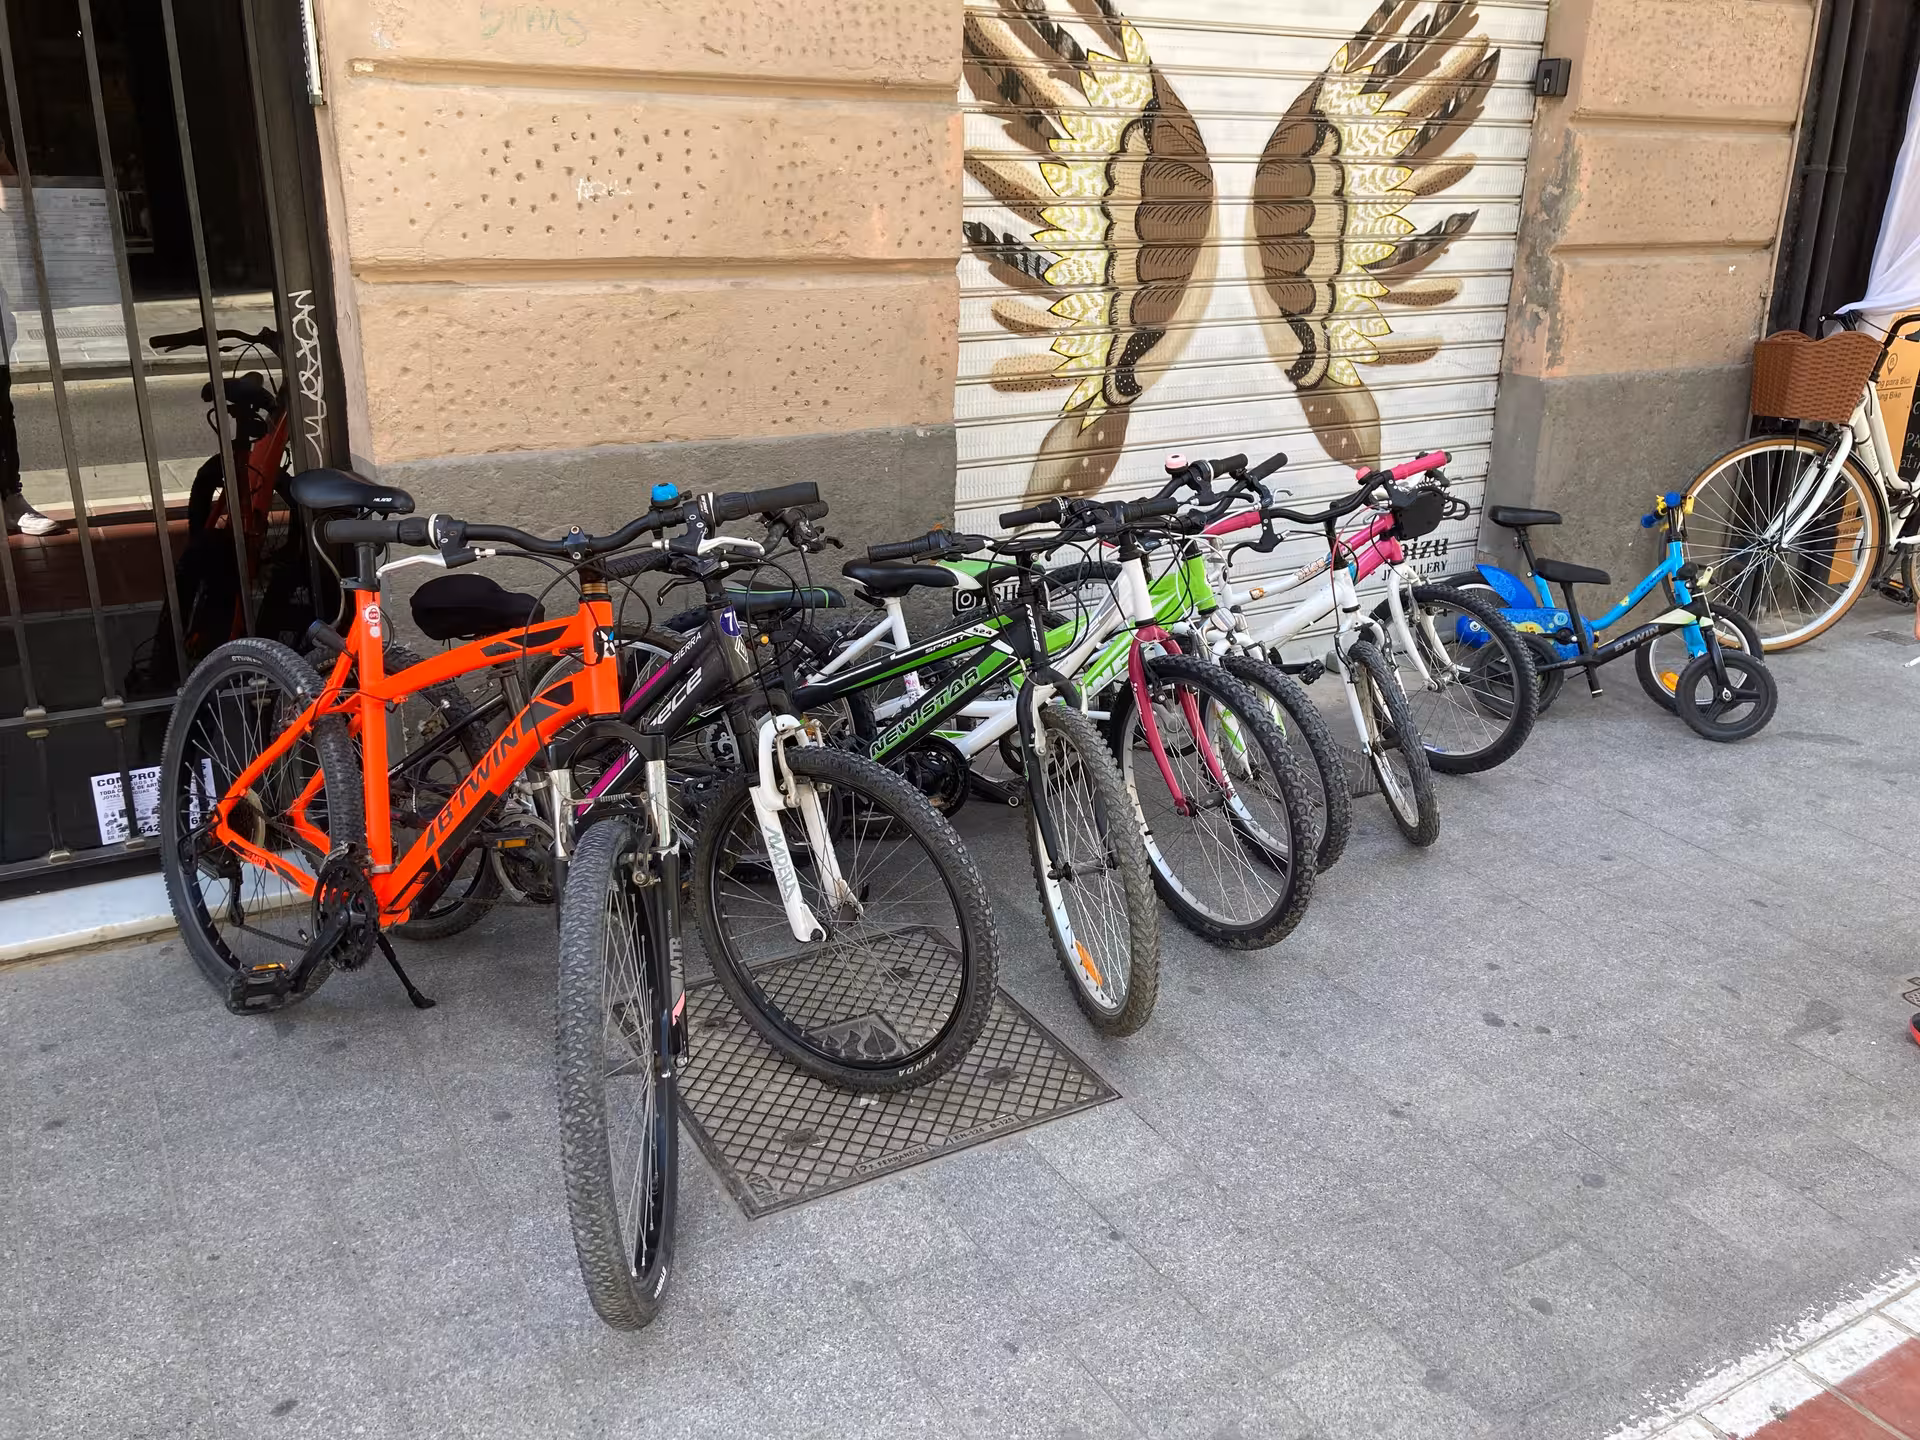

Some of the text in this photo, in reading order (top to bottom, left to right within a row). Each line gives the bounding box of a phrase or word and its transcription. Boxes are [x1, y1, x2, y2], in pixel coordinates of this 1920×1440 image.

[924, 634, 965, 655] SPORT
[1025, 603, 1042, 653] RACE
[671, 631, 702, 665] SIERRA
[670, 937, 684, 978] MTB
[898, 1050, 938, 1078] KENDA
